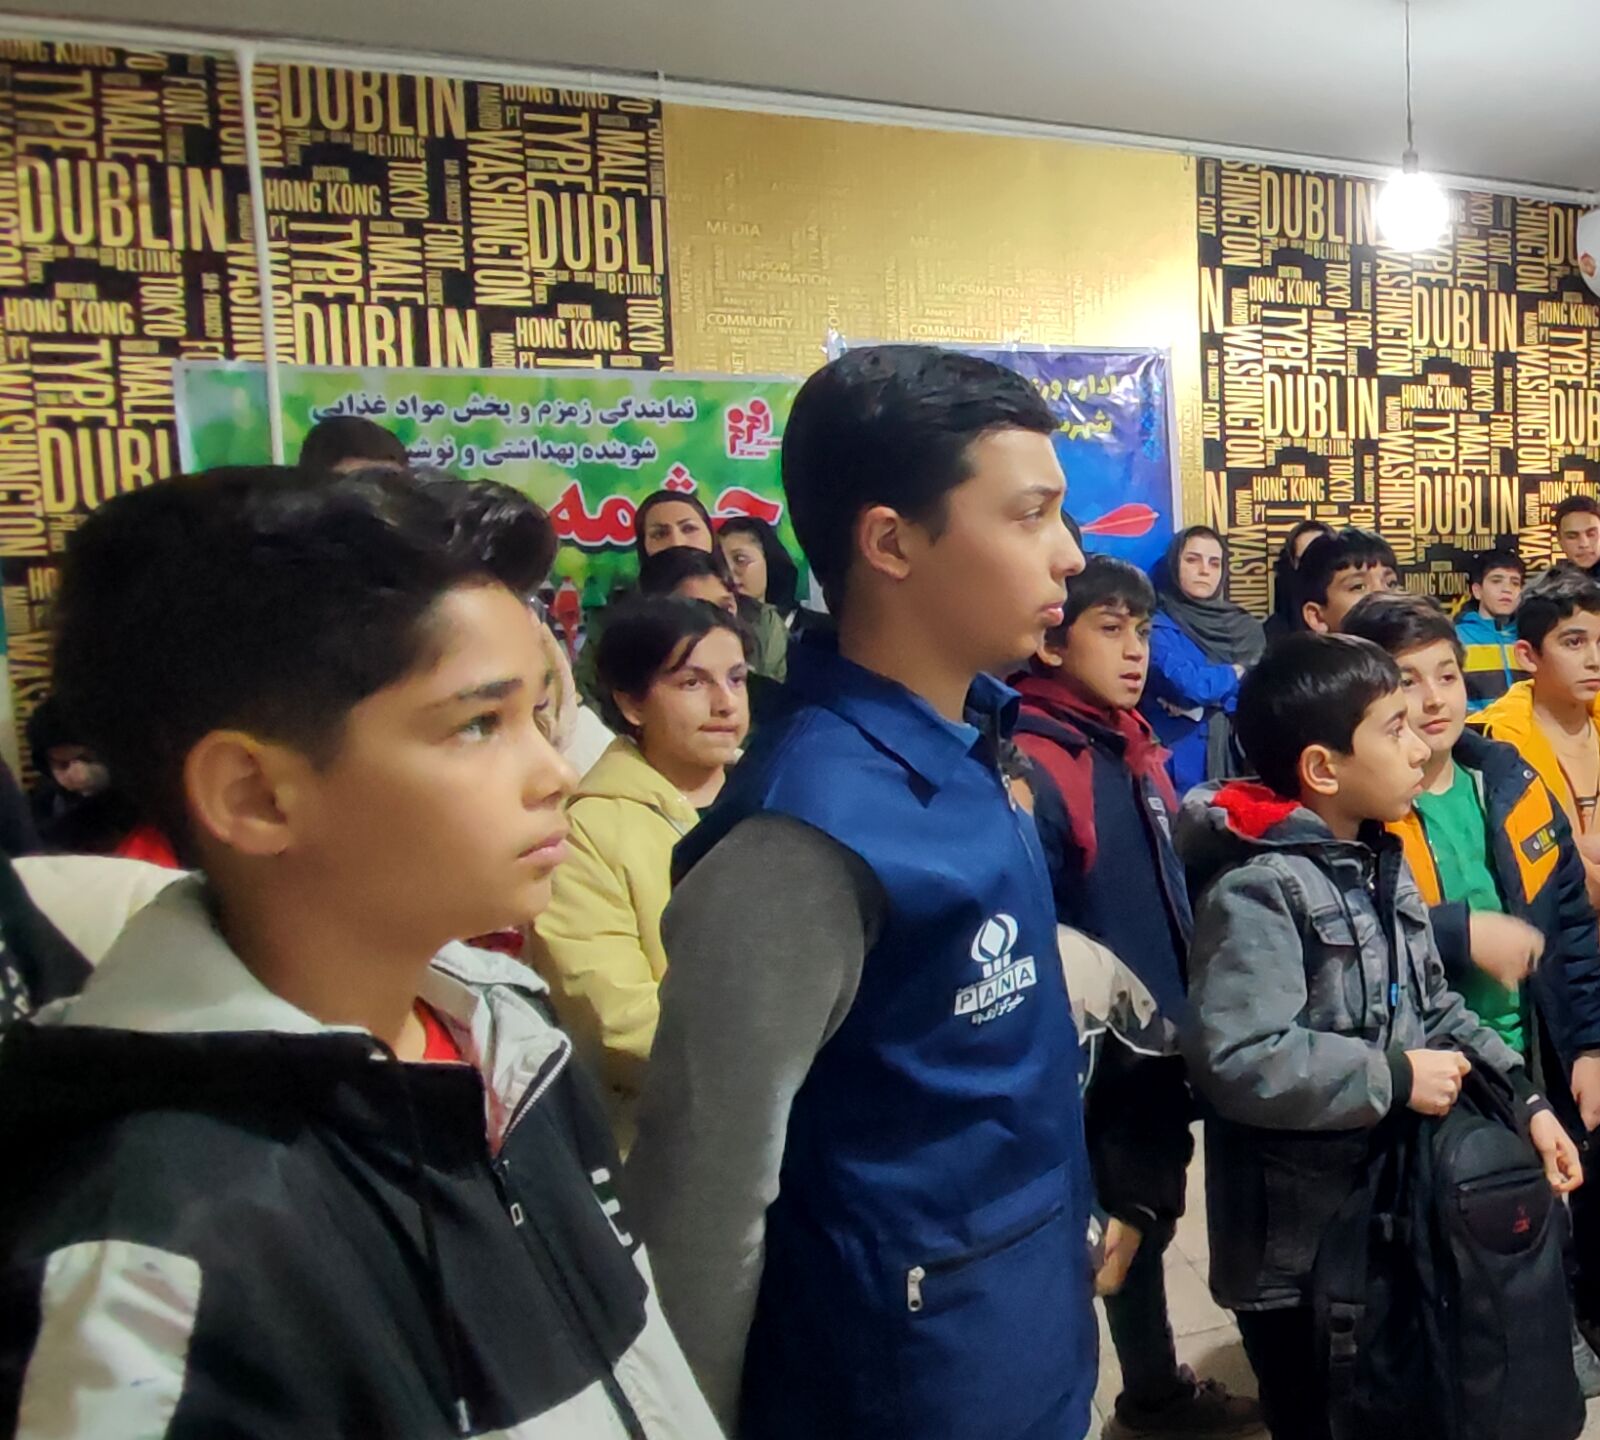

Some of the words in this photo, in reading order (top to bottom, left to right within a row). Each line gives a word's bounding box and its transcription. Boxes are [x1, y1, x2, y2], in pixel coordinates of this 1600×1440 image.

[15, 70, 97, 159] TYPE
[162, 75, 211, 130] FONT
[279, 64, 467, 140] DUBLIN
[506, 106, 521, 127] PT
[100, 88, 164, 164] MALE
[368, 134, 427, 159] BEIJING
[523, 112, 593, 192] TYPE
[596, 128, 649, 196] MALE
[18, 156, 227, 252] DUBLIN
[264, 179, 321, 214] HONG
[326, 182, 382, 216] KONG
[388, 161, 430, 219] TOKYO
[1260, 169, 1378, 246] DUBLIN
[270, 216, 288, 238] PT
[466, 130, 533, 307] WASHINGTON
[526, 189, 665, 275] DUBLI
[116, 248, 183, 273] BEIJING
[289, 219, 365, 304] TYPE
[423, 222, 467, 271] FONT
[1313, 241, 1351, 261] BEIJING
[1456, 236, 1488, 290] MALE
[1489, 229, 1512, 266] FONT
[367, 236, 425, 305] MALE
[608, 273, 662, 296] BEIJING
[737, 270, 832, 288] INFORMATION
[1325, 262, 1351, 309] TOKYO
[139, 275, 188, 337] TOKYO
[1231, 287, 1249, 325] MADRID
[1249, 275, 1284, 303] HONG
[1287, 278, 1322, 306] KONG
[1376, 240, 1414, 376] WASHINGTON
[3, 298, 68, 332] HONG
[71, 300, 136, 335] KONG
[515, 317, 566, 348] HONG
[571, 320, 622, 350] KONG
[627, 297, 665, 352] TOKYO
[706, 313, 794, 329] COMMUNITY
[909, 323, 989, 340] COMMUNITY
[1346, 311, 1372, 350] FONT
[1412, 285, 1517, 353] DUBLIN
[1524, 311, 1539, 346] MADRID
[1538, 301, 1567, 325] HONG
[1570, 303, 1600, 328] KONG
[293, 302, 481, 368] DUBLIN
[1262, 308, 1309, 374] TYPE
[1311, 321, 1346, 376] MALE
[1460, 350, 1494, 367] BEIJING
[1549, 329, 1588, 388] TYPE
[31, 339, 118, 427] TYPE
[1222, 323, 1264, 468] WASHINGTON
[1401, 384, 1433, 409] HONG
[1436, 387, 1468, 411] KONG
[1471, 369, 1495, 412] TOKYO
[312, 395, 387, 424] غذایی
[395, 395, 445, 425] مواد
[453, 395, 511, 425] پخش
[520, 407, 531, 424] و
[537, 399, 592, 426] زمزم
[598, 397, 695, 425] نمایندگی
[1262, 372, 1379, 440] DUBLIN
[1386, 396, 1402, 431] MADRID
[1516, 345, 1550, 474] WASHINGTON
[1316, 438, 1354, 457] BEIJING
[1414, 412, 1456, 475] TYPE
[1458, 423, 1490, 475] MALE
[1490, 414, 1514, 449] FONT
[463, 447, 476, 466] و
[483, 439, 576, 466] بهداشتی
[579, 438, 657, 465] شوینده
[1252, 476, 1287, 502] HONG
[1290, 477, 1326, 502] KONG
[1328, 458, 1355, 502] TOKYO
[1235, 489, 1252, 526] MADRID
[1414, 475, 1519, 535] DUBLIN
[1525, 493, 1539, 526] MADRID
[1404, 572, 1436, 596] HONG
[1439, 573, 1470, 595] KONG
[959, 966, 1034, 1011] PANA
